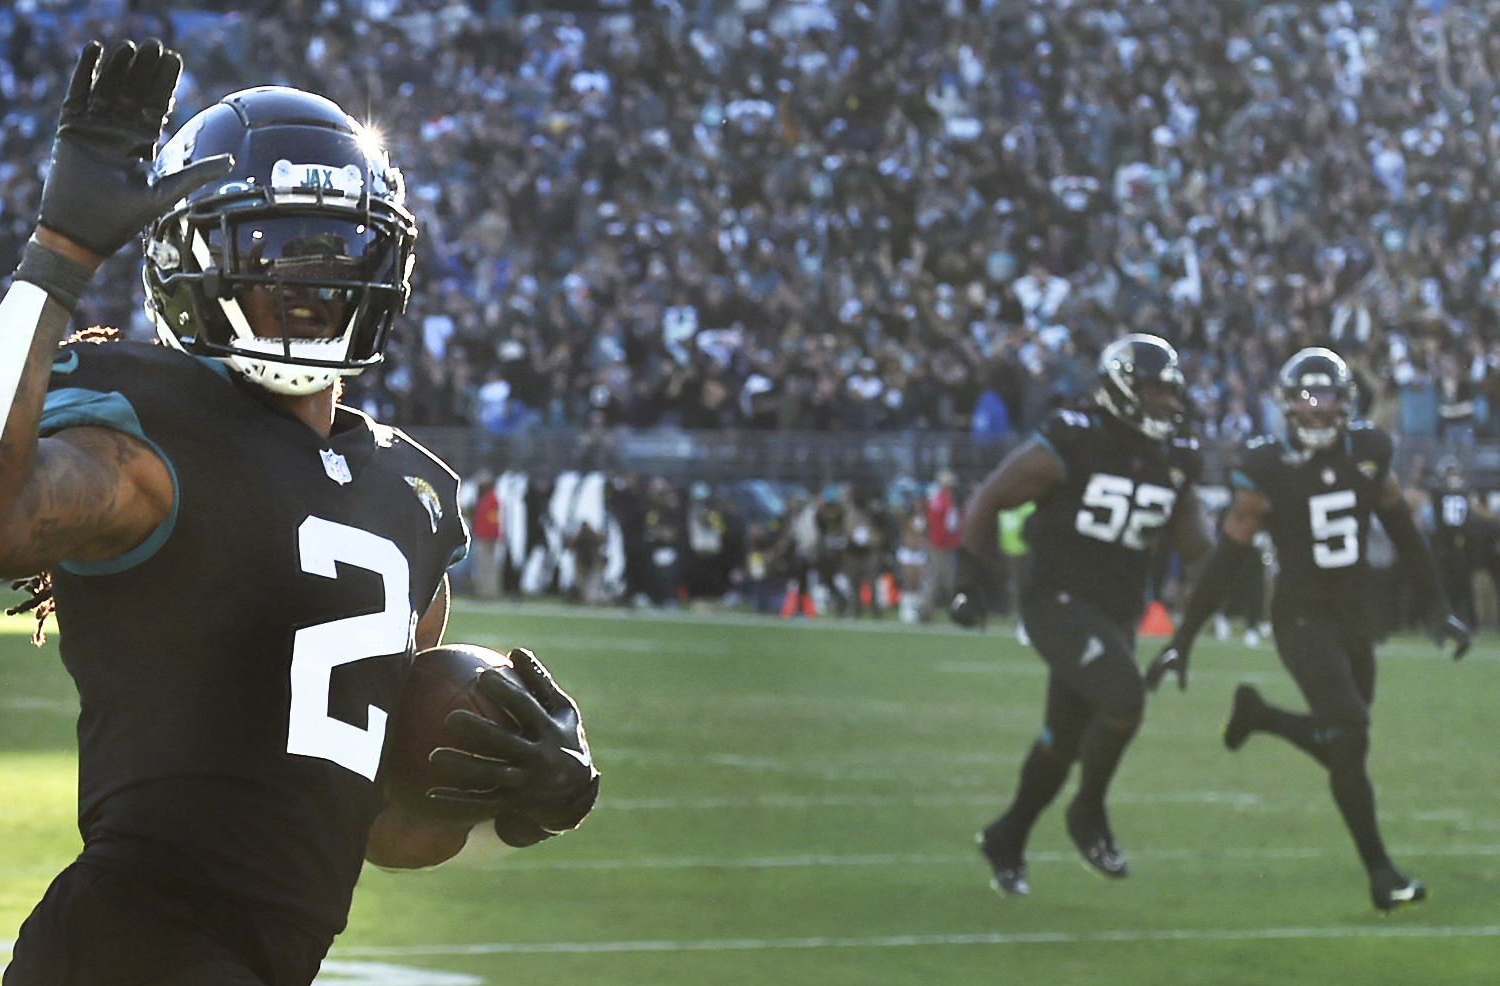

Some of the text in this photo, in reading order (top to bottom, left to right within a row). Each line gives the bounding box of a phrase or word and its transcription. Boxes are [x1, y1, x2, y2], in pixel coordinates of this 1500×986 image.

[300, 168, 334, 190] JAX
[1075, 472, 1178, 551] 52
[1308, 488, 1360, 569] 5
[286, 514, 411, 783] 2
